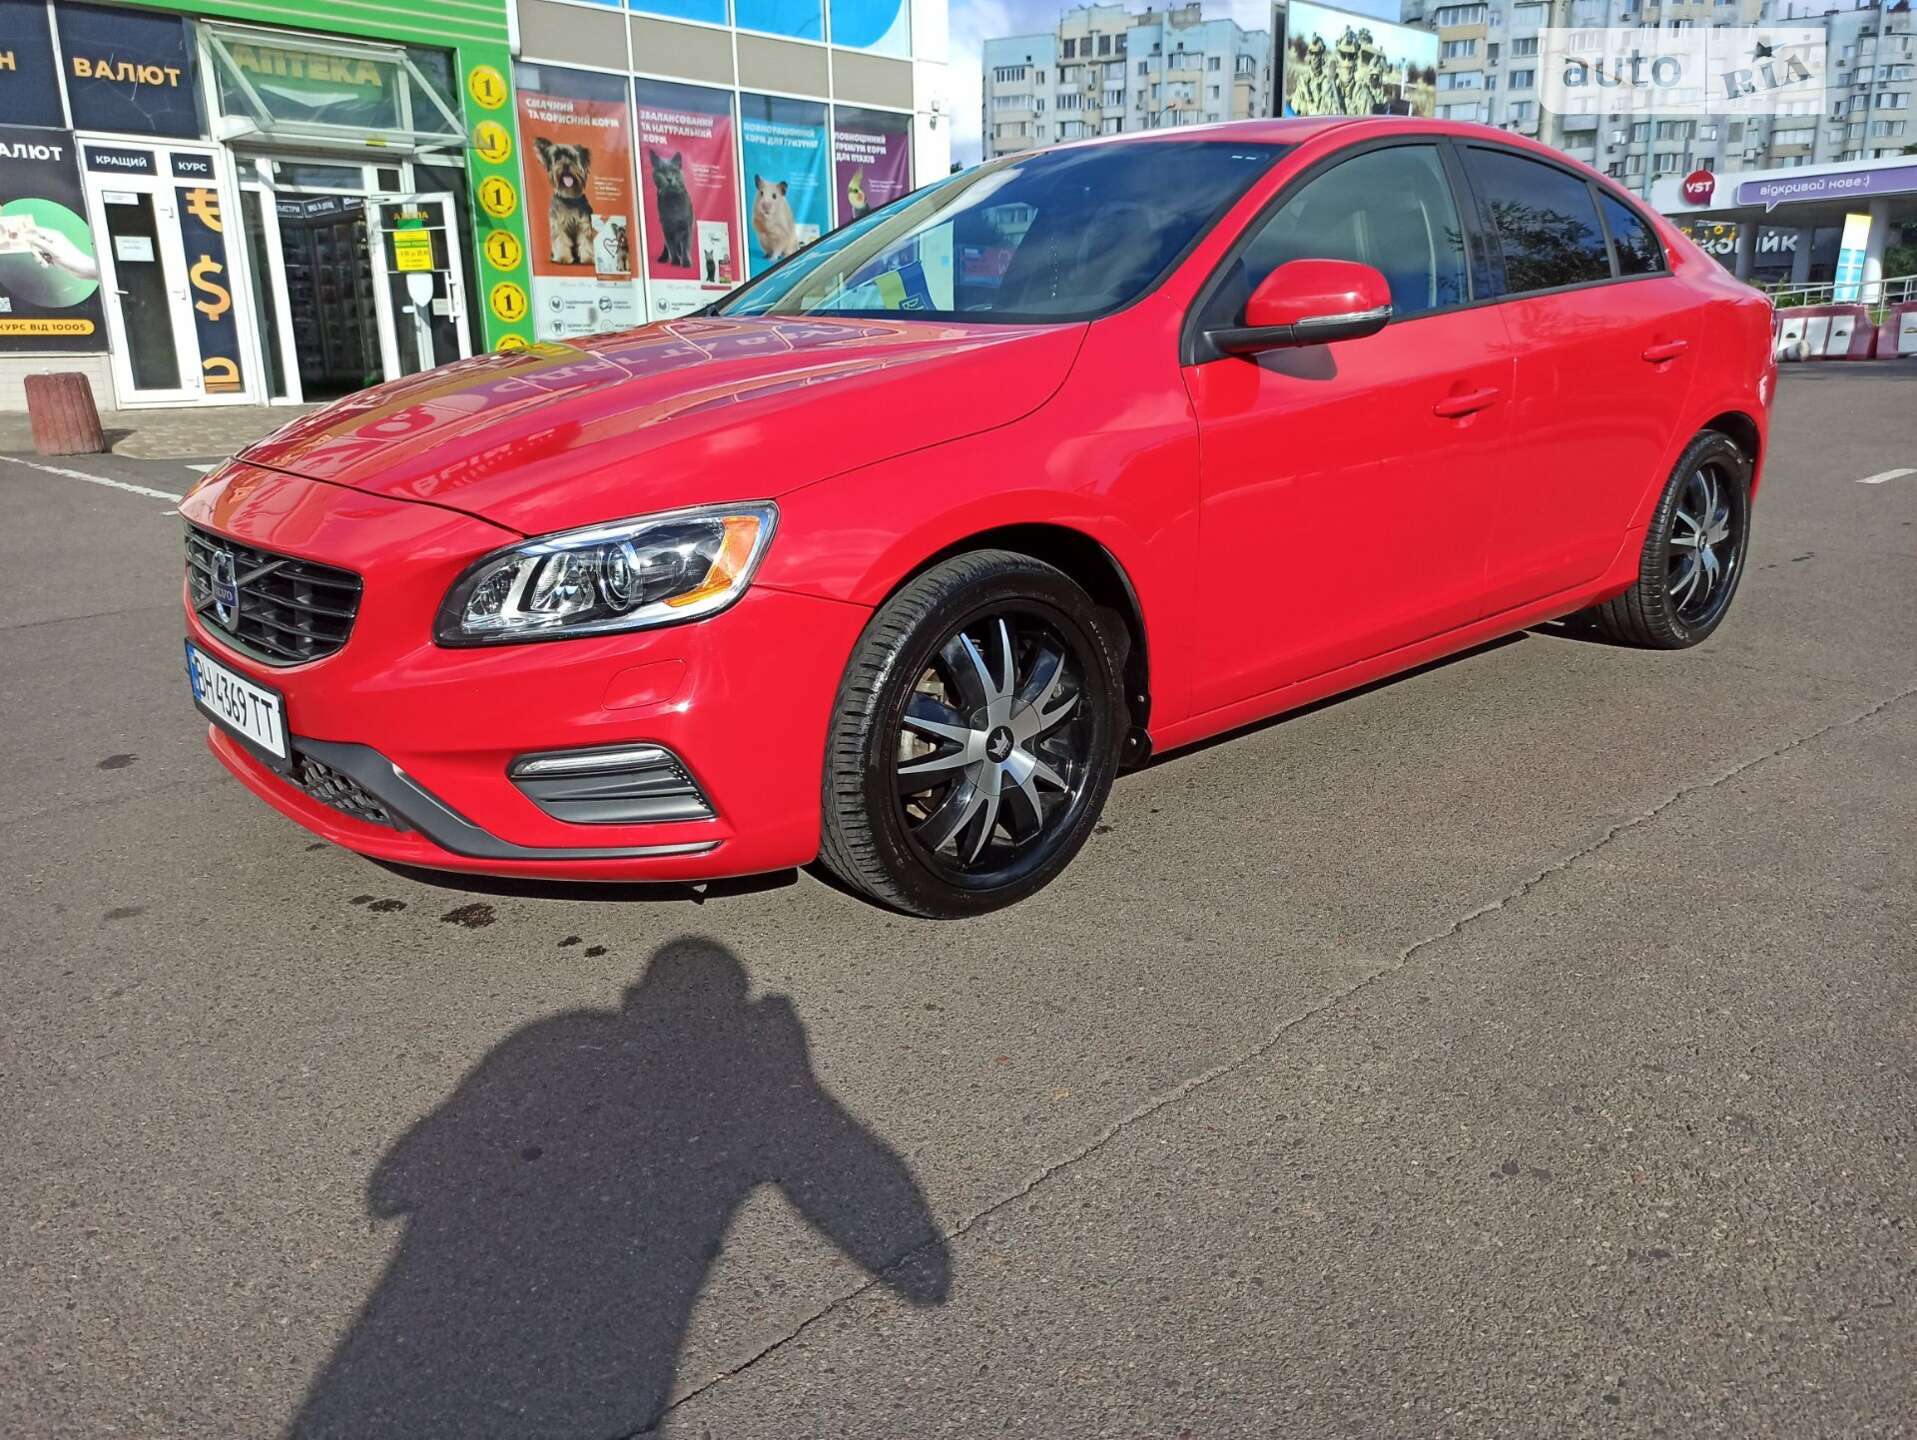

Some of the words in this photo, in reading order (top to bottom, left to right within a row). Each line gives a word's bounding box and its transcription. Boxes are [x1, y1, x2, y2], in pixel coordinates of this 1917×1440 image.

[73, 57, 181, 87] ВАЛЮТ
[232, 45, 383, 87] АПТЕКА
[526, 98, 574, 113] СМАЧНИЙ
[540, 112, 590, 127] КОРИСНИЙ
[591, 118, 620, 128] КОРМ
[652, 123, 712, 139] НАТУРАЛЬНИЙ
[643, 134, 668, 145] КОРМ
[95, 155, 148, 168] КРАЩИЙ
[178, 161, 208, 172] КУРС
[1760, 179, 1826, 197] відкривай
[216, 673, 248, 727] 4369
[247, 691, 274, 744] TT
